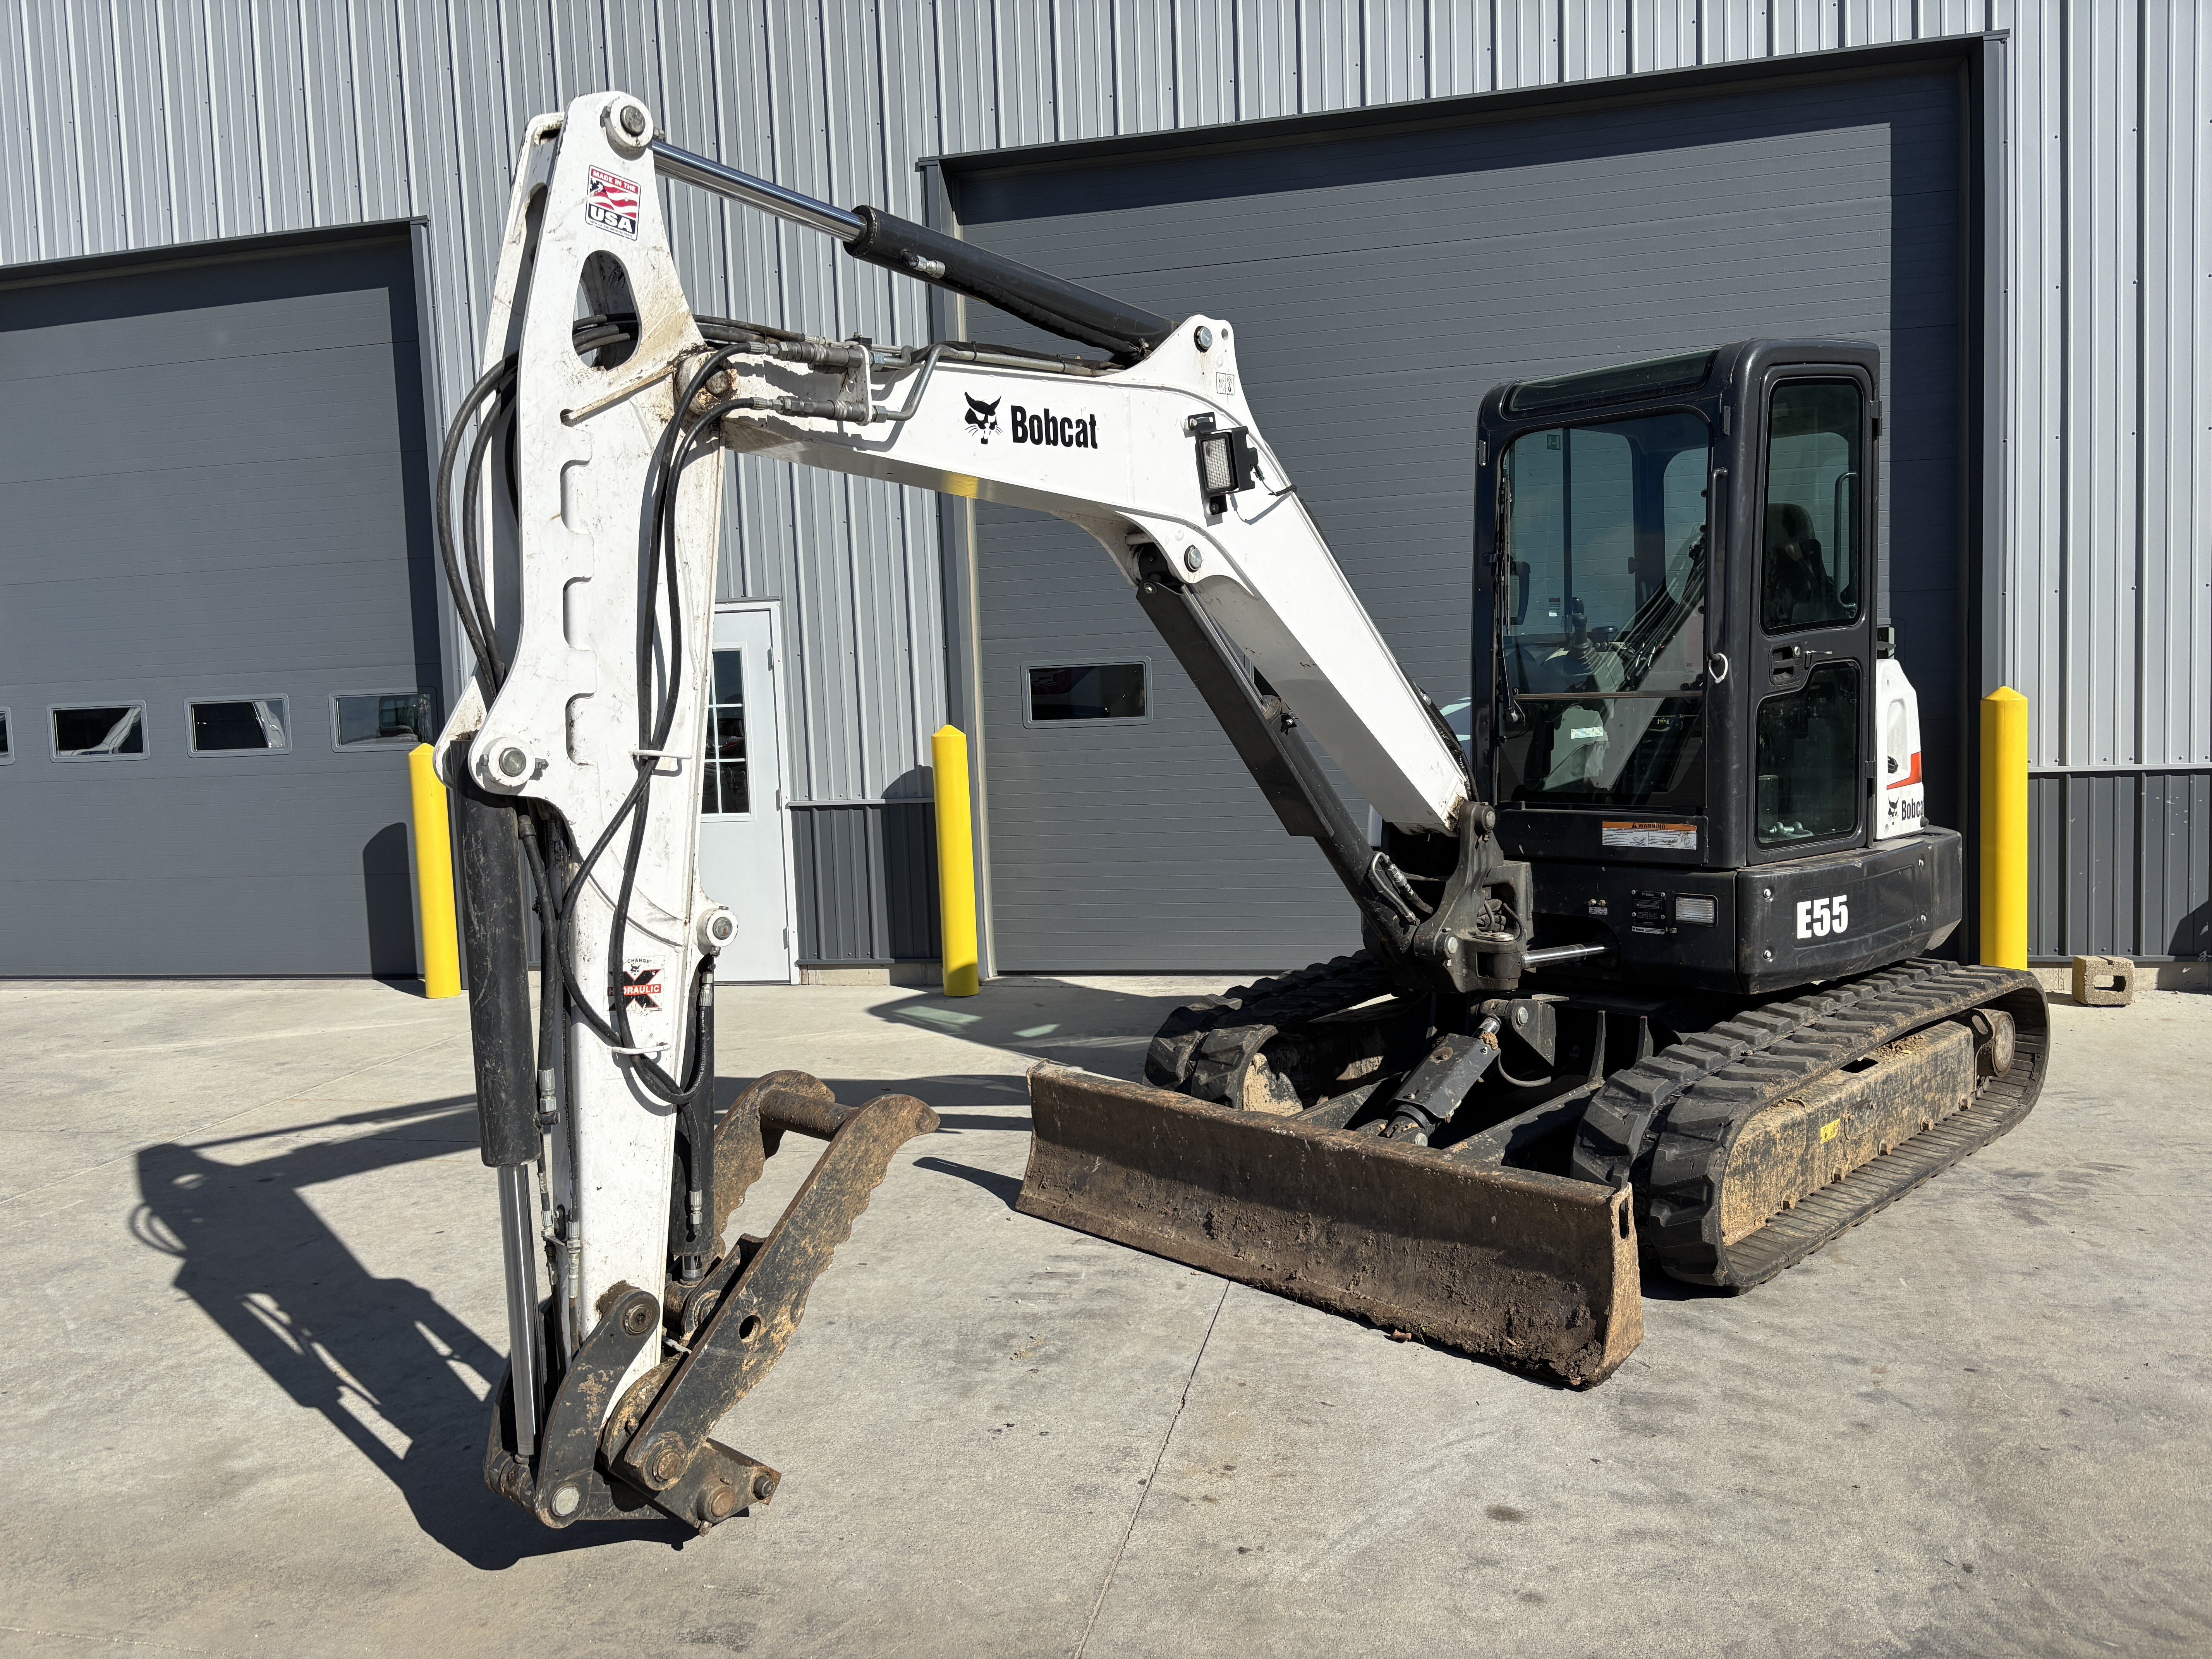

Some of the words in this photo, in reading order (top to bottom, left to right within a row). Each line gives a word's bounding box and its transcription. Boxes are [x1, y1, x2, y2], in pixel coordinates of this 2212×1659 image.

[593, 170, 613, 184] MADE
[615, 179, 622, 187] IN
[623, 183, 636, 192] THE
[590, 205, 633, 233] USA
[1011, 405, 1098, 449] Bobcat
[1901, 798, 1923, 821] Bobca
[1797, 895, 1848, 939] E55
[609, 985, 659, 995] HDRAULIC
